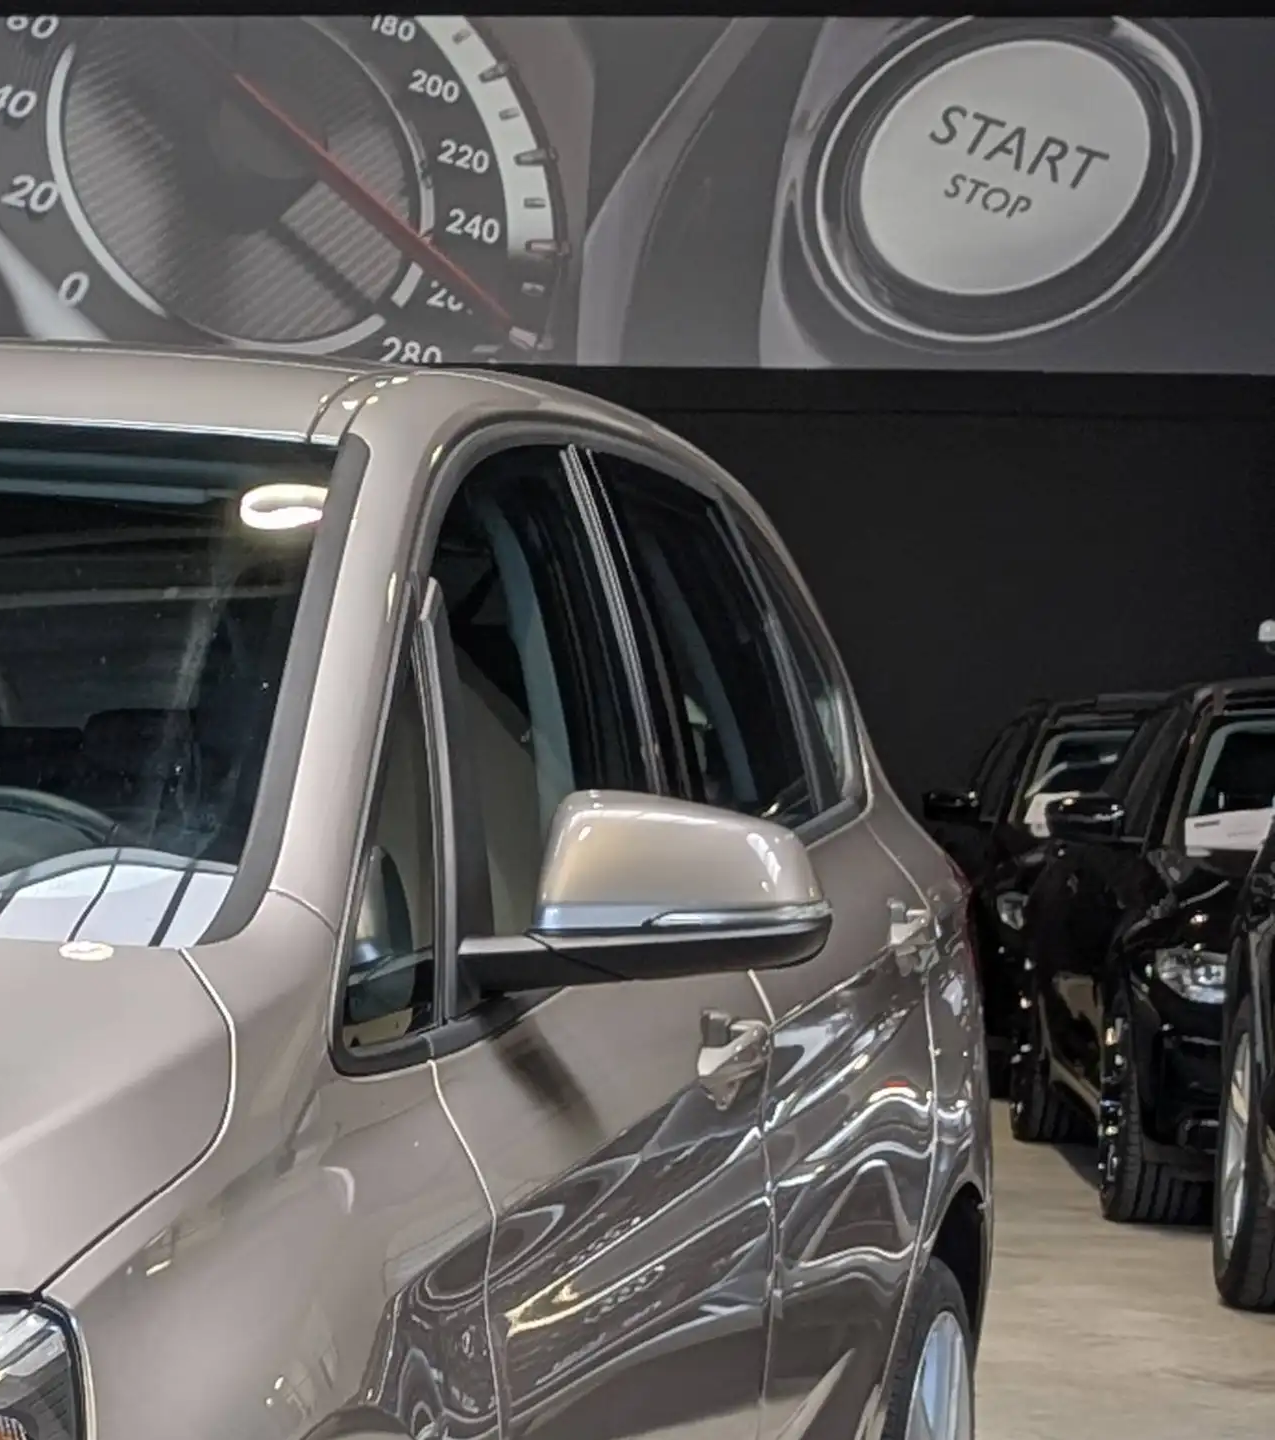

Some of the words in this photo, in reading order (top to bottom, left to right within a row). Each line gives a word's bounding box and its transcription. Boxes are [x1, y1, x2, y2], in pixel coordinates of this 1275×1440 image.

[370, 14, 416, 42] 180
[408, 68, 460, 103] 200
[437, 139, 491, 175] 220
[929, 104, 1110, 191] START
[0, 175, 59, 214] 20
[944, 174, 1032, 219] STOP
[445, 209, 501, 245] 240
[57, 271, 90, 308] 0
